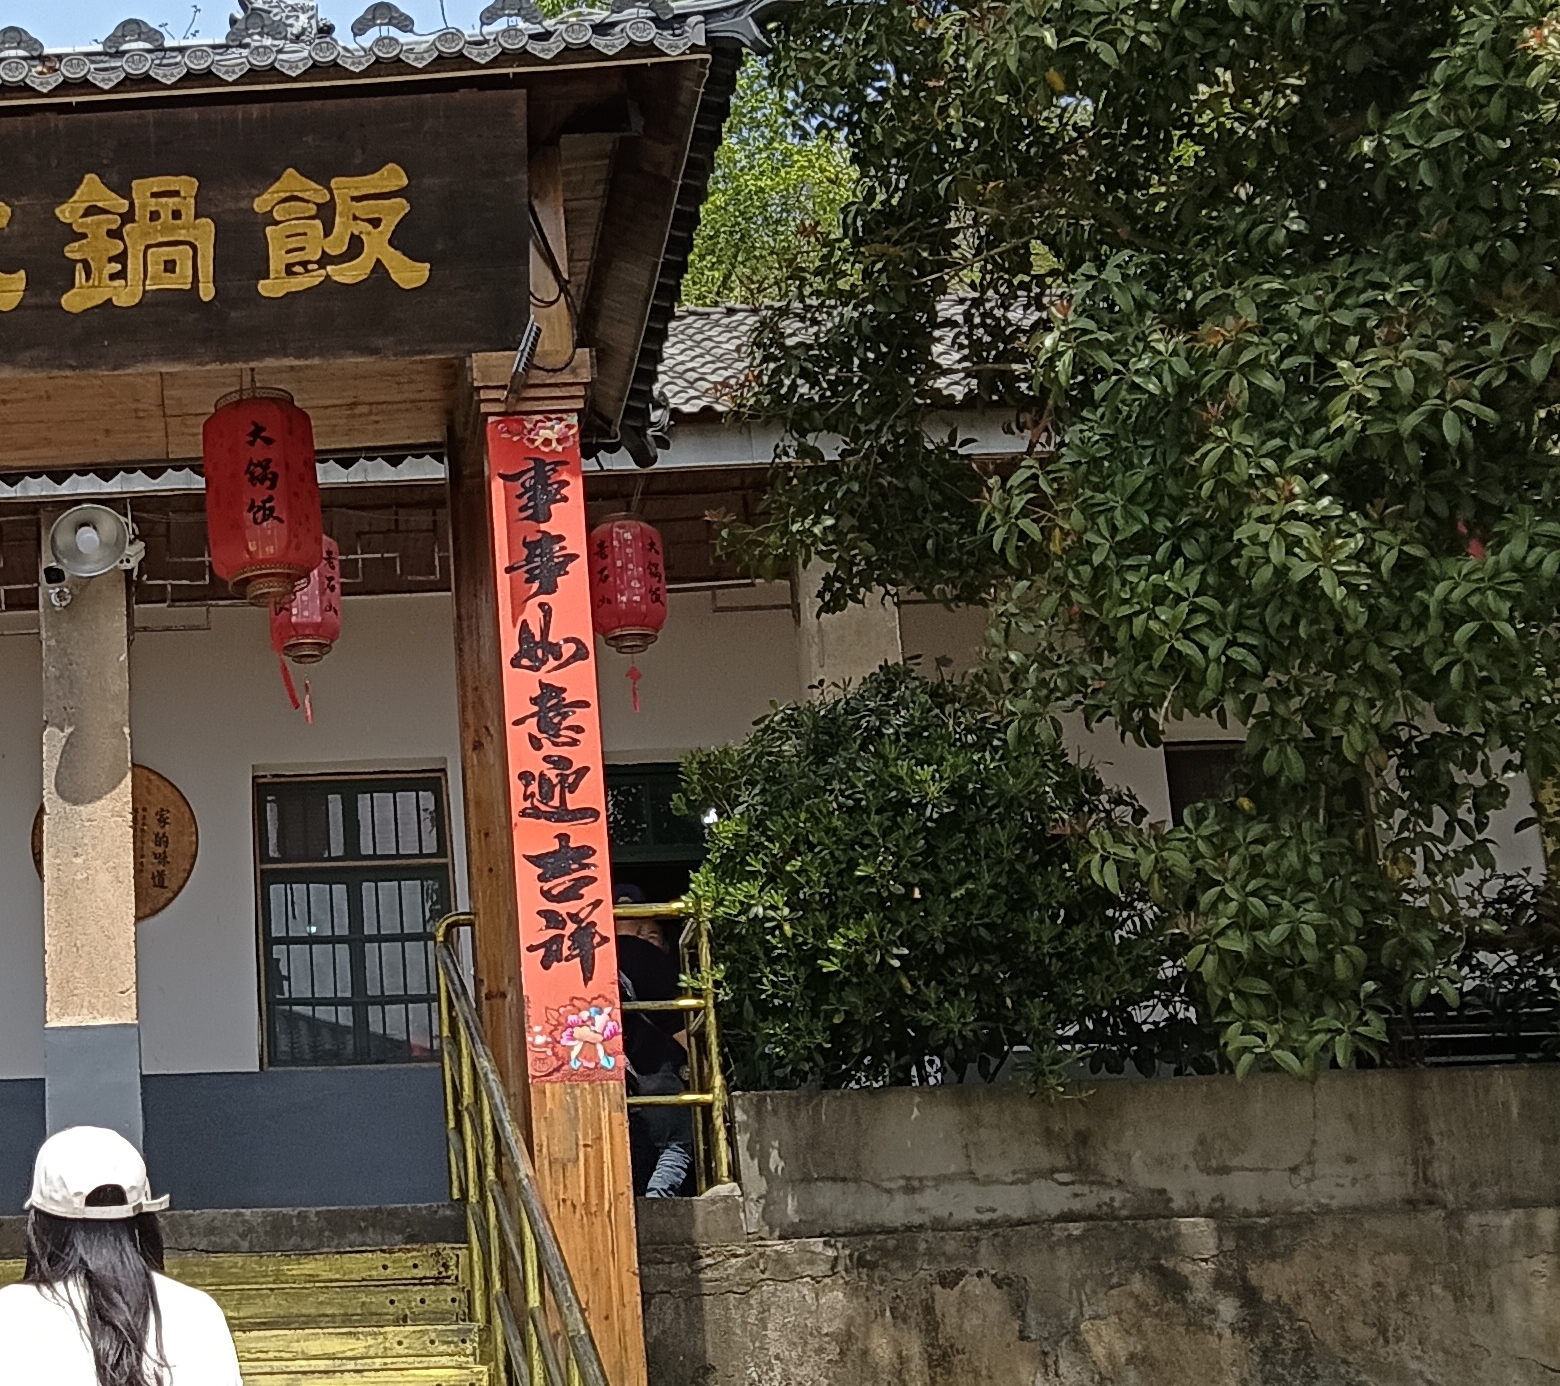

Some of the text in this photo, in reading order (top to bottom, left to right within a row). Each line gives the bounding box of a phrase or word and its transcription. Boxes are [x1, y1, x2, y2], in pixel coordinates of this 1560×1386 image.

[244, 420, 285, 526] 大锅饭
[497, 456, 610, 988] 事事如意迎吉祥
[150, 807, 172, 890] 家的味道
